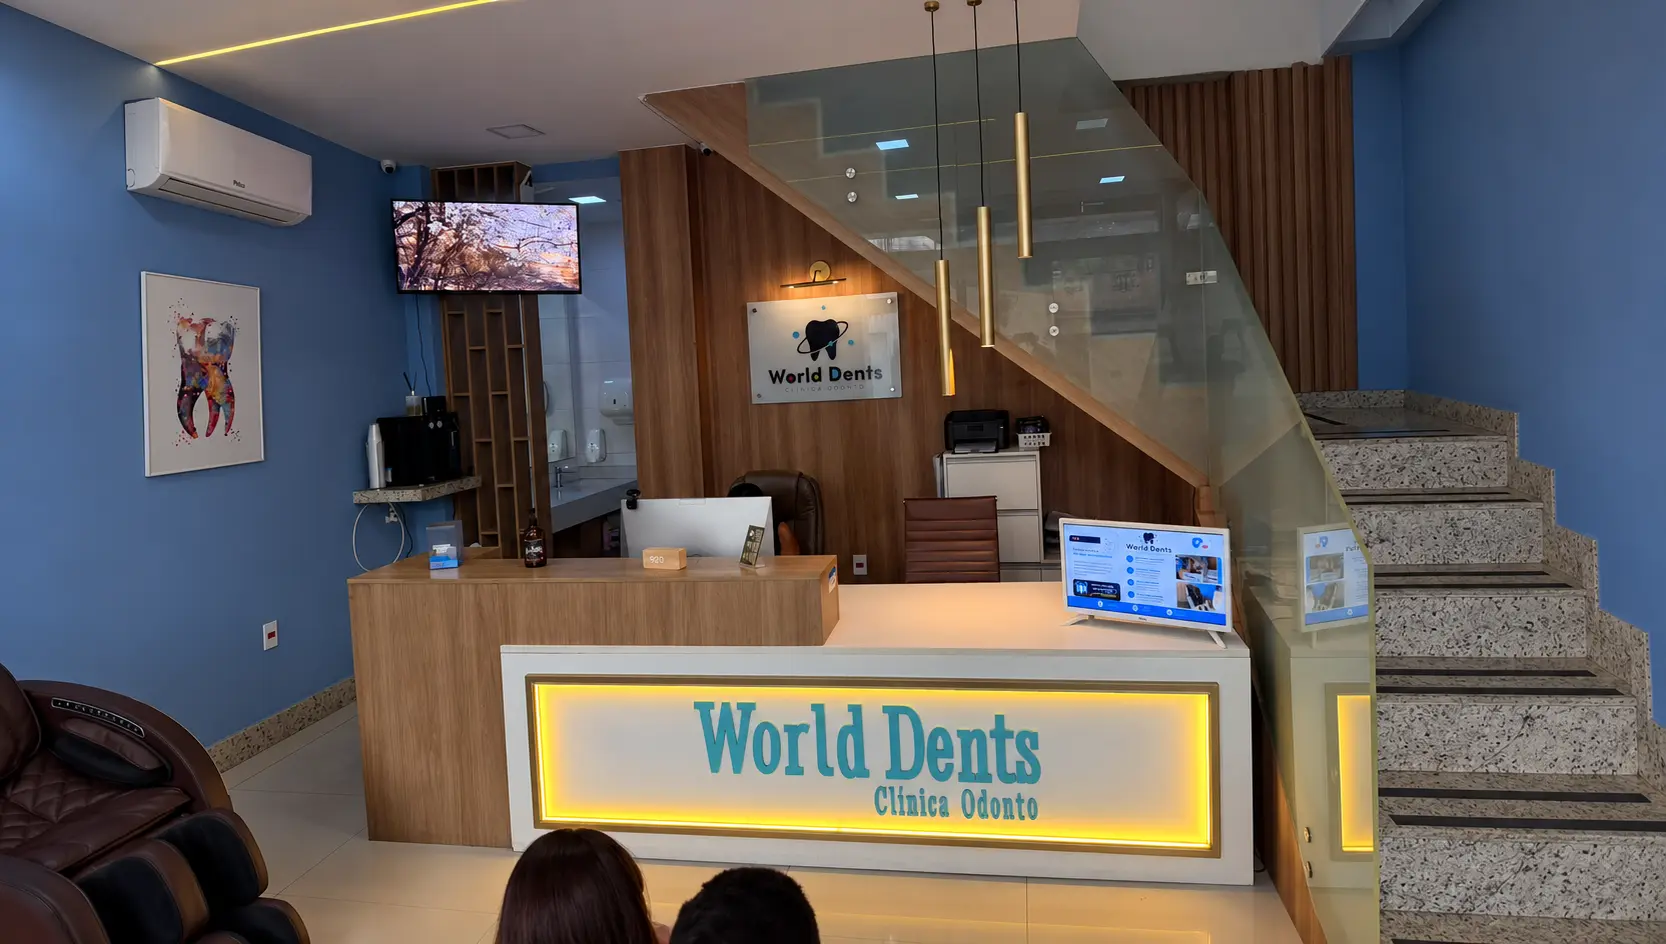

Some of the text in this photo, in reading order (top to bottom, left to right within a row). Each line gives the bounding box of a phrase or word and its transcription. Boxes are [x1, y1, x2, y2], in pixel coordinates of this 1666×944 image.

[768, 365, 883, 385] World Dents
[1125, 543, 1172, 553] World Dents
[694, 701, 1042, 785] World Dents
[874, 785, 1039, 821] Clínica Odonto
